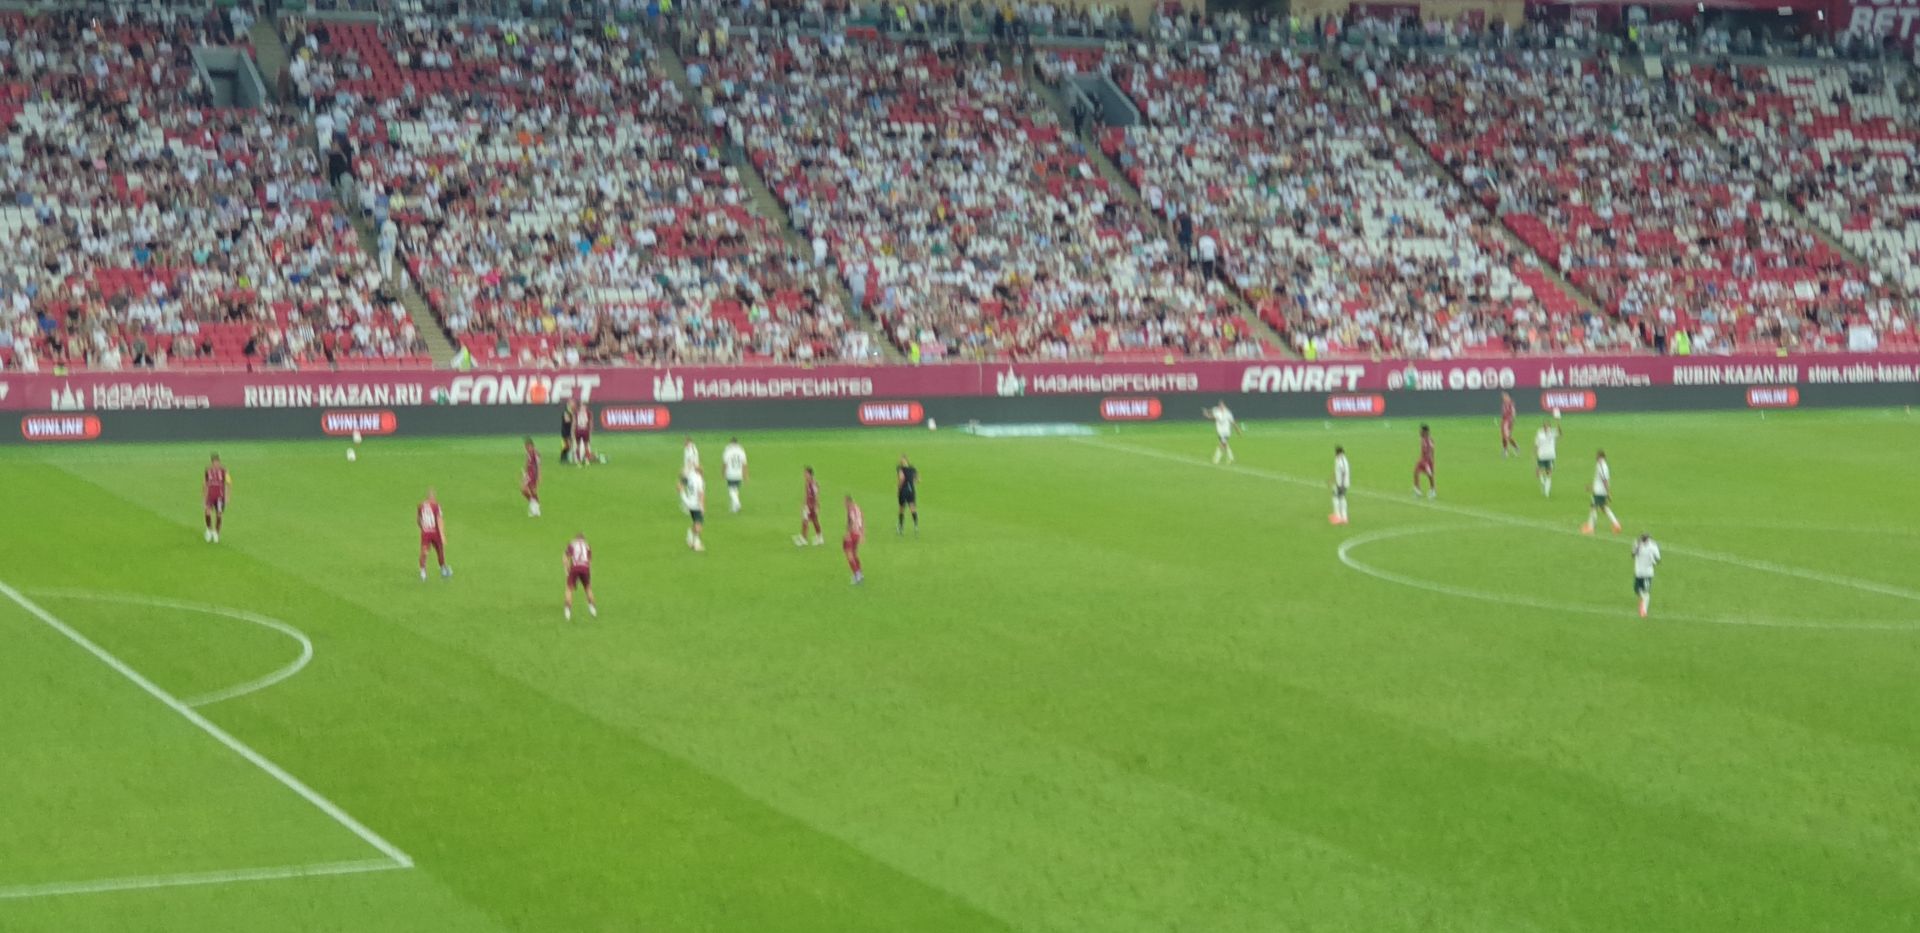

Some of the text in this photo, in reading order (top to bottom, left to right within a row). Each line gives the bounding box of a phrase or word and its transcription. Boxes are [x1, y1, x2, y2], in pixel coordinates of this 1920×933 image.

[1751, 389, 1788, 403] WINLINE
[864, 405, 909, 420] WINLINE
[1105, 400, 1149, 417] WINLINE
[1332, 397, 1373, 412] WINLINE
[328, 414, 380, 430] WINLINE
[606, 408, 655, 426] WINLINE
[28, 418, 83, 435] WINLINE
